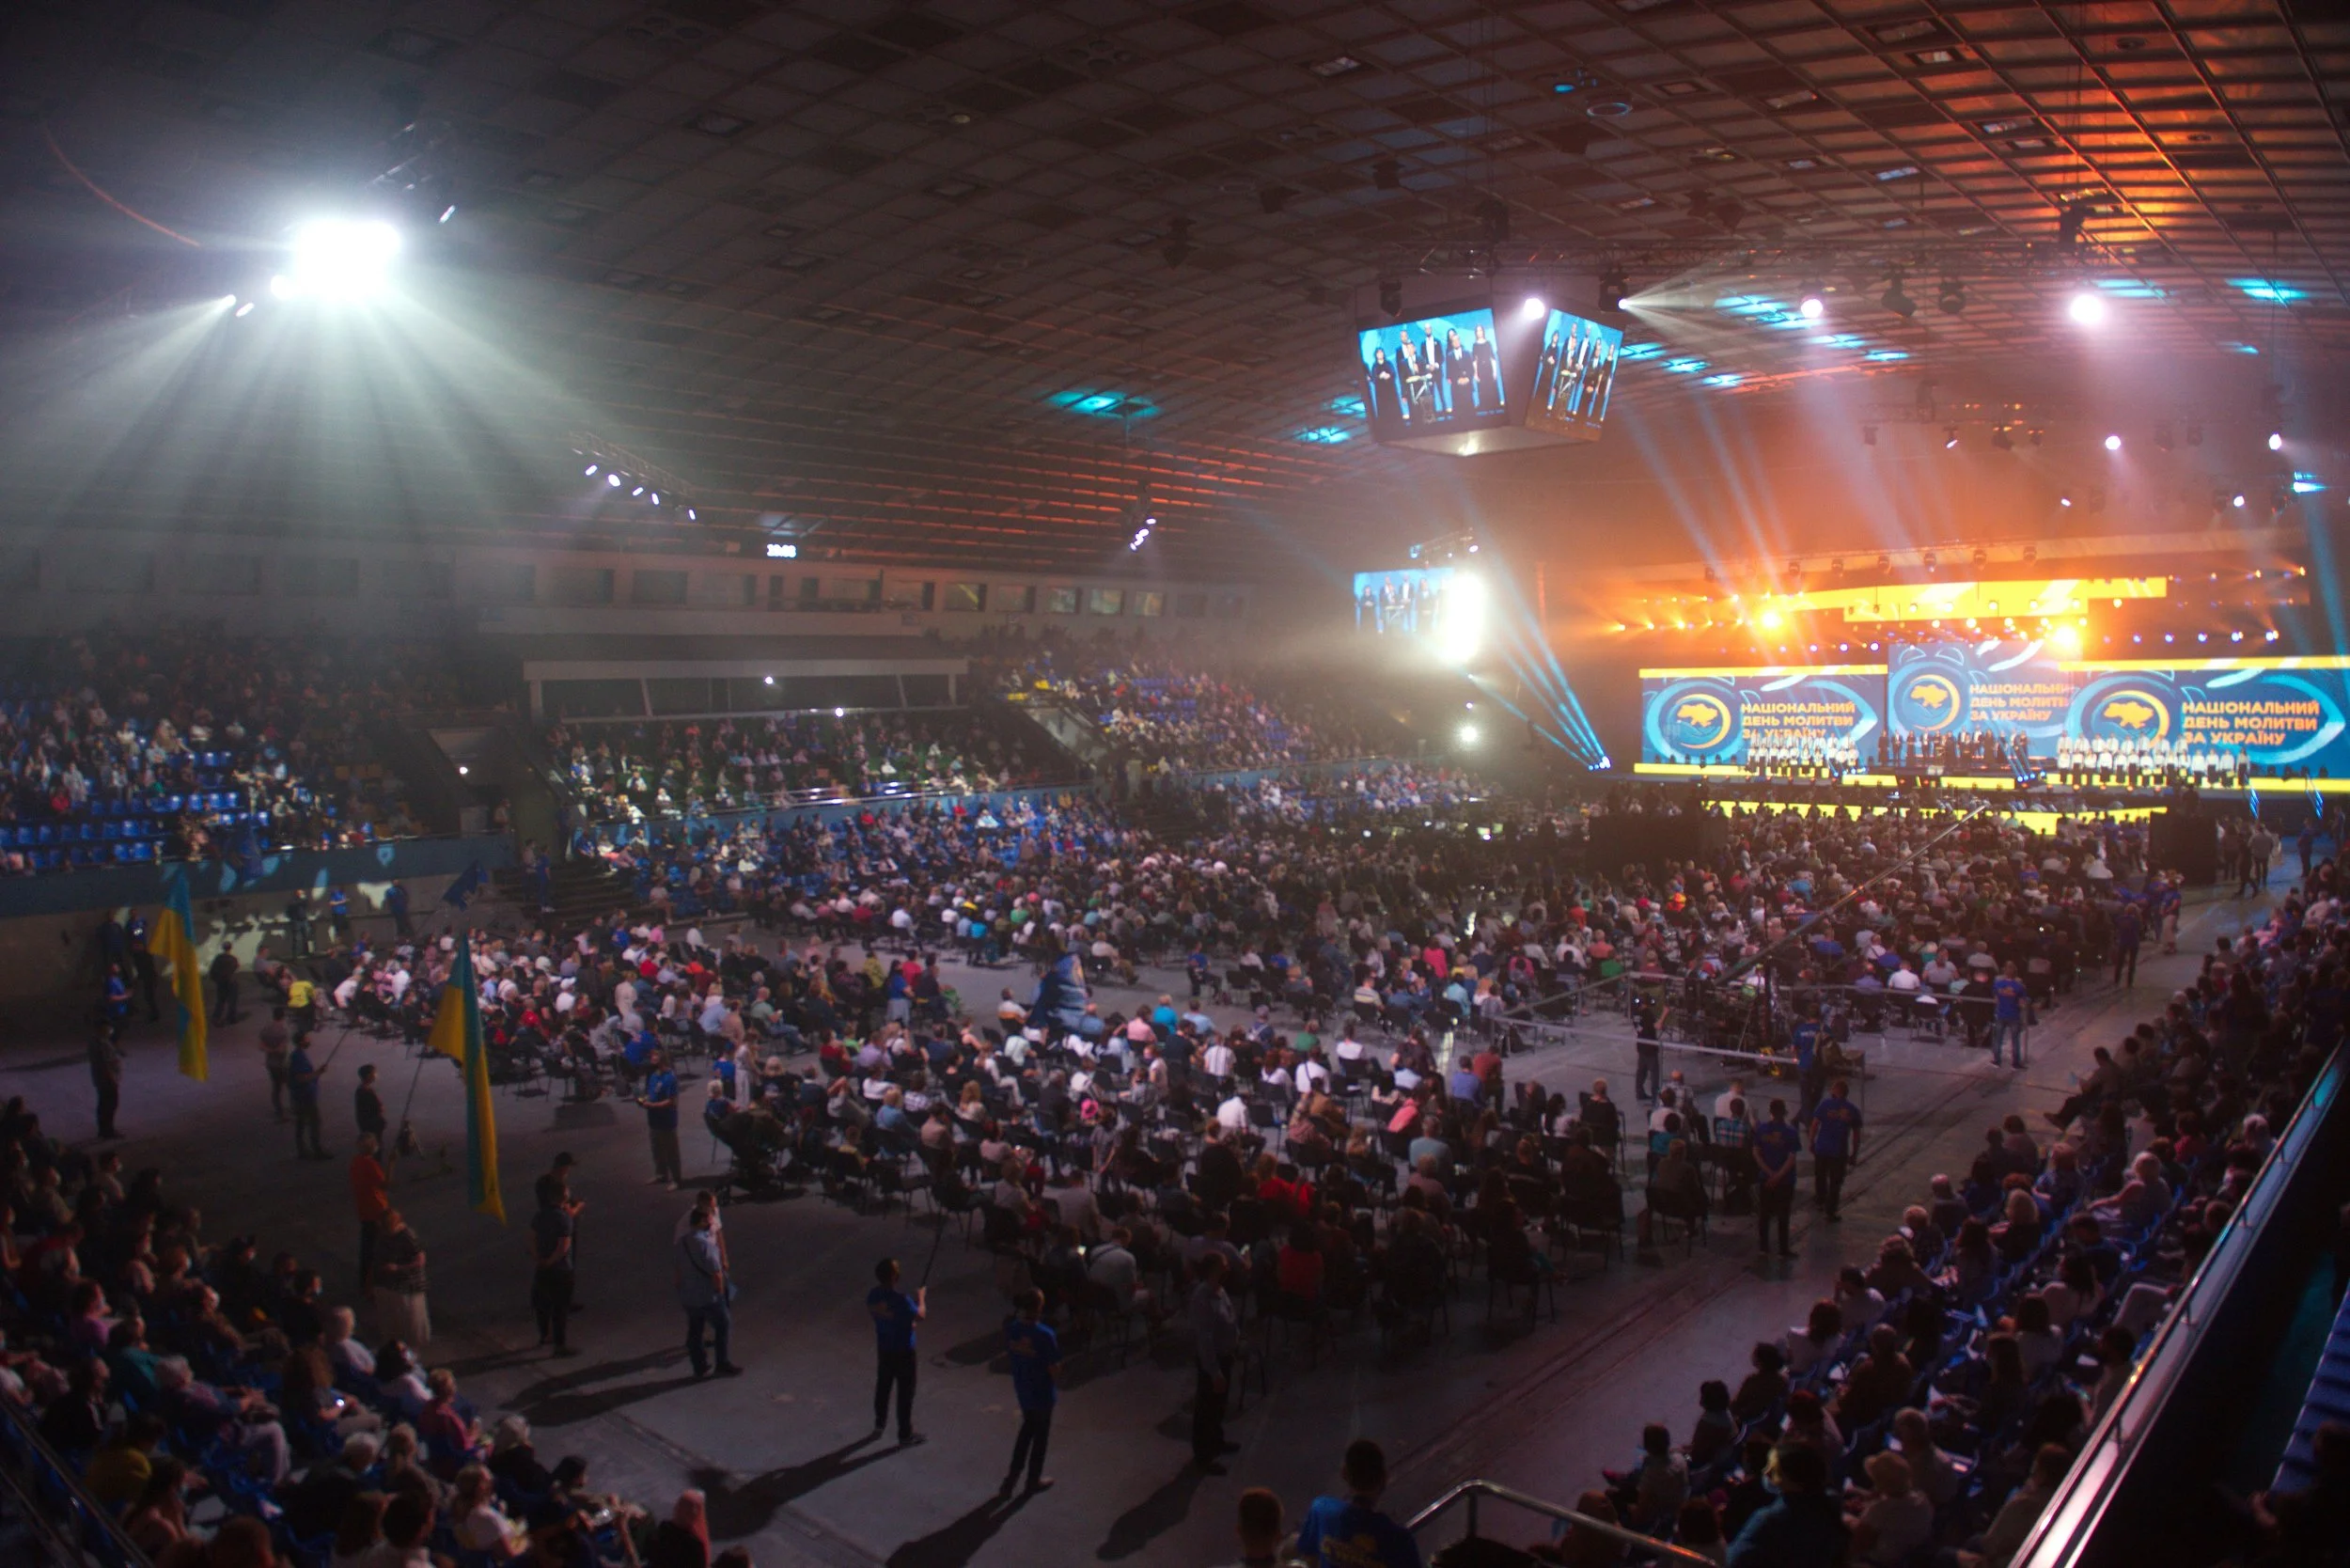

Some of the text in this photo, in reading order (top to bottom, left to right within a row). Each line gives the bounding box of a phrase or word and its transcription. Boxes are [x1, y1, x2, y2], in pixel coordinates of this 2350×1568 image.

[1741, 701, 1856, 713] НАЦІОНАЛЬНИЙ
[1970, 697, 2007, 708] ДЕНЬ
[2182, 700, 2320, 714] НАЦІОНАЛЬНИЙ
[1743, 715, 1854, 727] ДЕНЬ МОЛИТВИ
[1970, 708, 2052, 721] ЗА УКРАЇНУ
[2183, 716, 2317, 730] ДЕНЬ МОЛИТВИ
[2184, 730, 2286, 745] ЗА УКРАЇНУ
